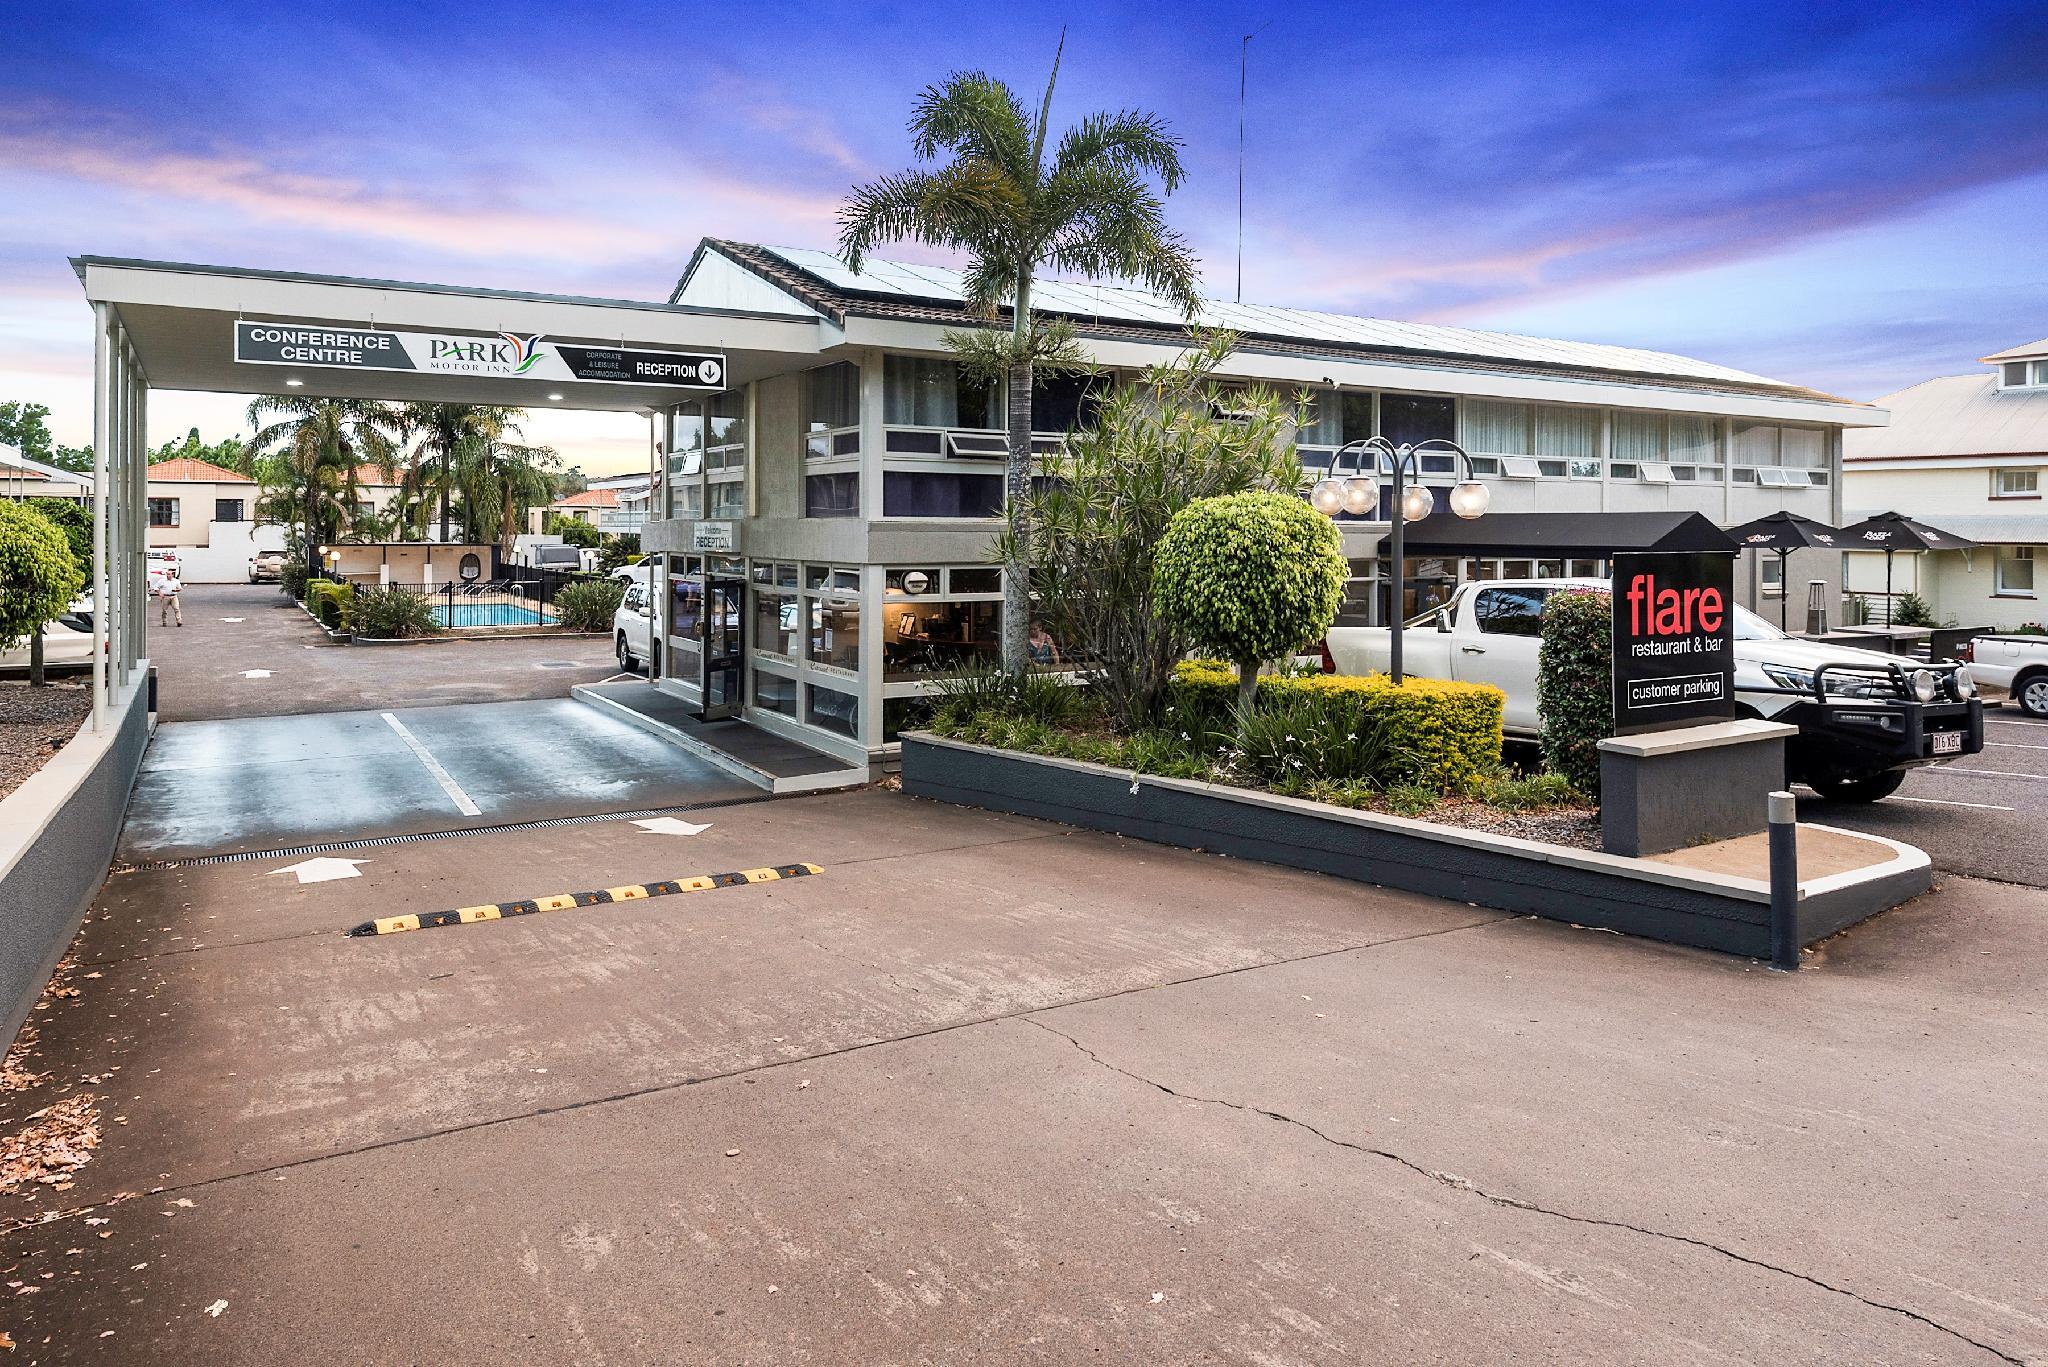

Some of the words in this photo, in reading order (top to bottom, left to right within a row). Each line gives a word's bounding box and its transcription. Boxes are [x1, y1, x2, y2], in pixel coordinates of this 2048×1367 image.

[250, 328, 391, 350] CONFERENCE
[280, 346, 363, 364] CENTRE
[430, 340, 510, 364] PARK
[586, 352, 622, 361] CORPORATE
[430, 361, 479, 372] MOTOR
[487, 365, 511, 374] INN
[594, 361, 619, 370] LEISURE
[636, 362, 696, 379] RECEPTION
[578, 369, 631, 380] ACCOMMODATION
[695, 536, 730, 549] RECEPTION
[1626, 574, 1724, 636] flare
[1631, 638, 1691, 657] restaurant
[1694, 636, 1703, 653] &
[1705, 635, 1724, 652] bar
[1632, 683, 1681, 700] customer
[1683, 678, 1720, 698] parking
